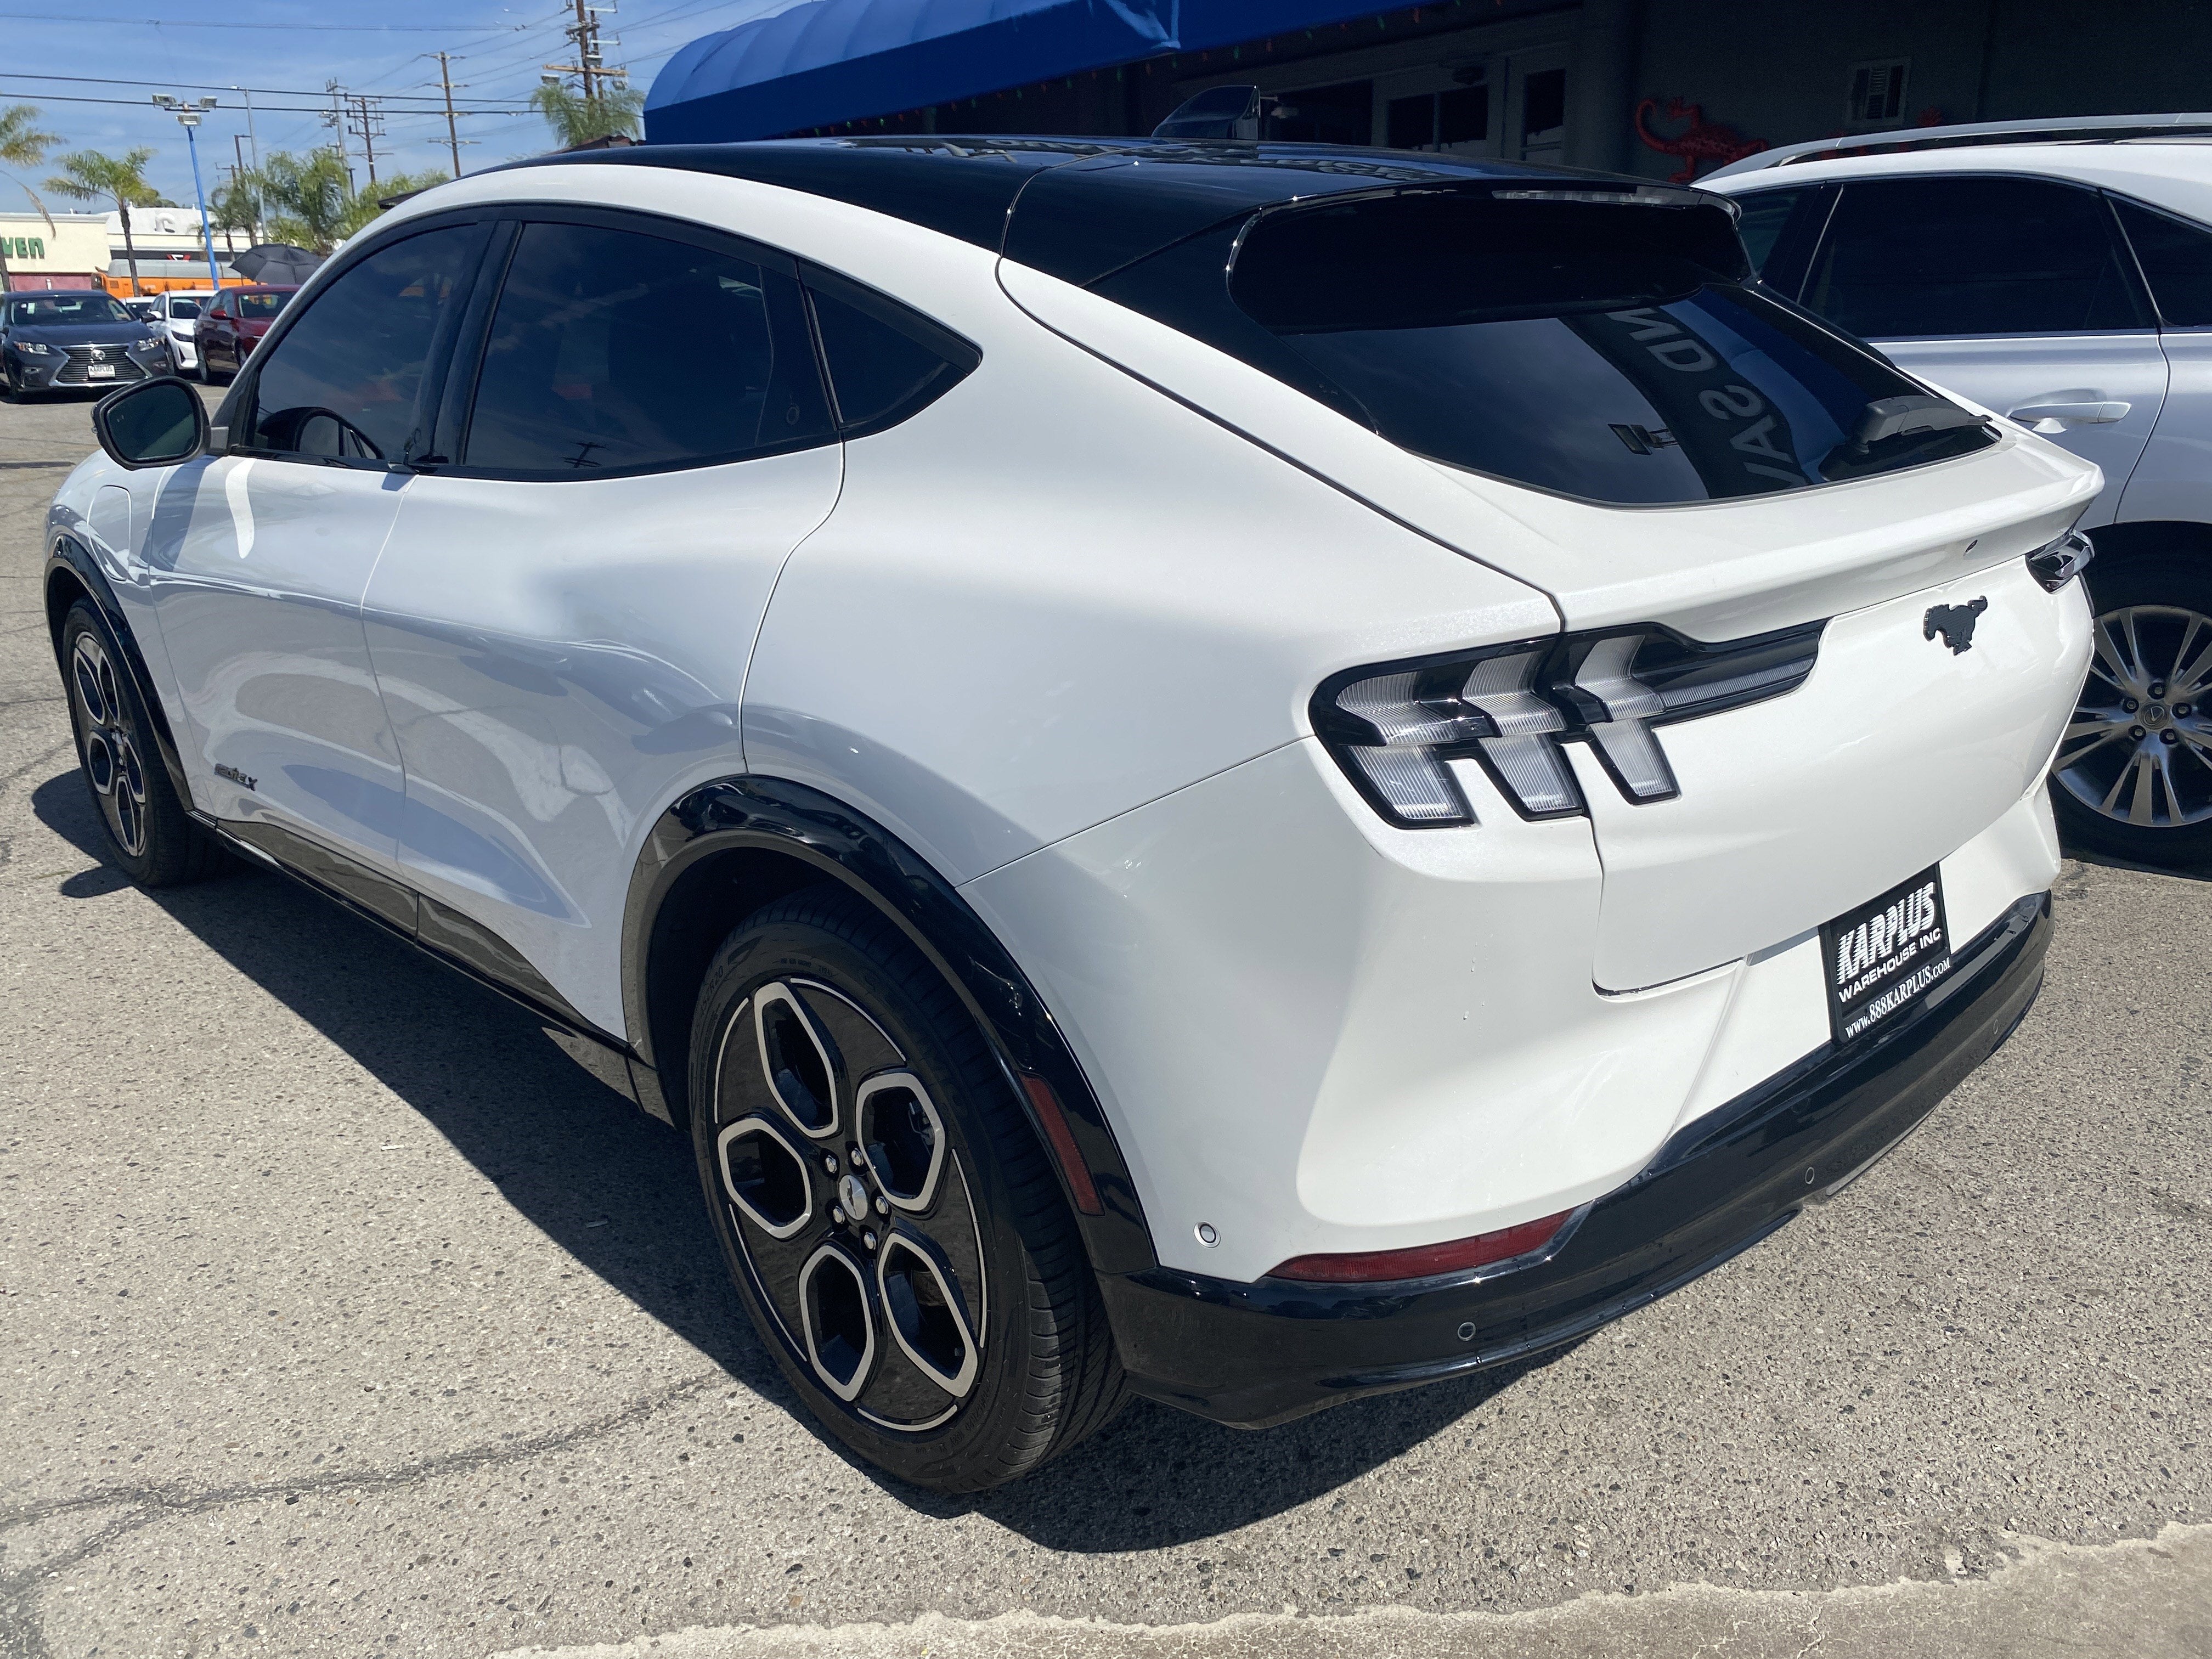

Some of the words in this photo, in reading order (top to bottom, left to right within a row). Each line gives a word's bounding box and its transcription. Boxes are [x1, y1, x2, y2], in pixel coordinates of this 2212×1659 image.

[1837, 882, 1936, 984] KARPLUS
[1838, 942, 1917, 1003] WAREHOUSE
[1920, 927, 1941, 949] INC
